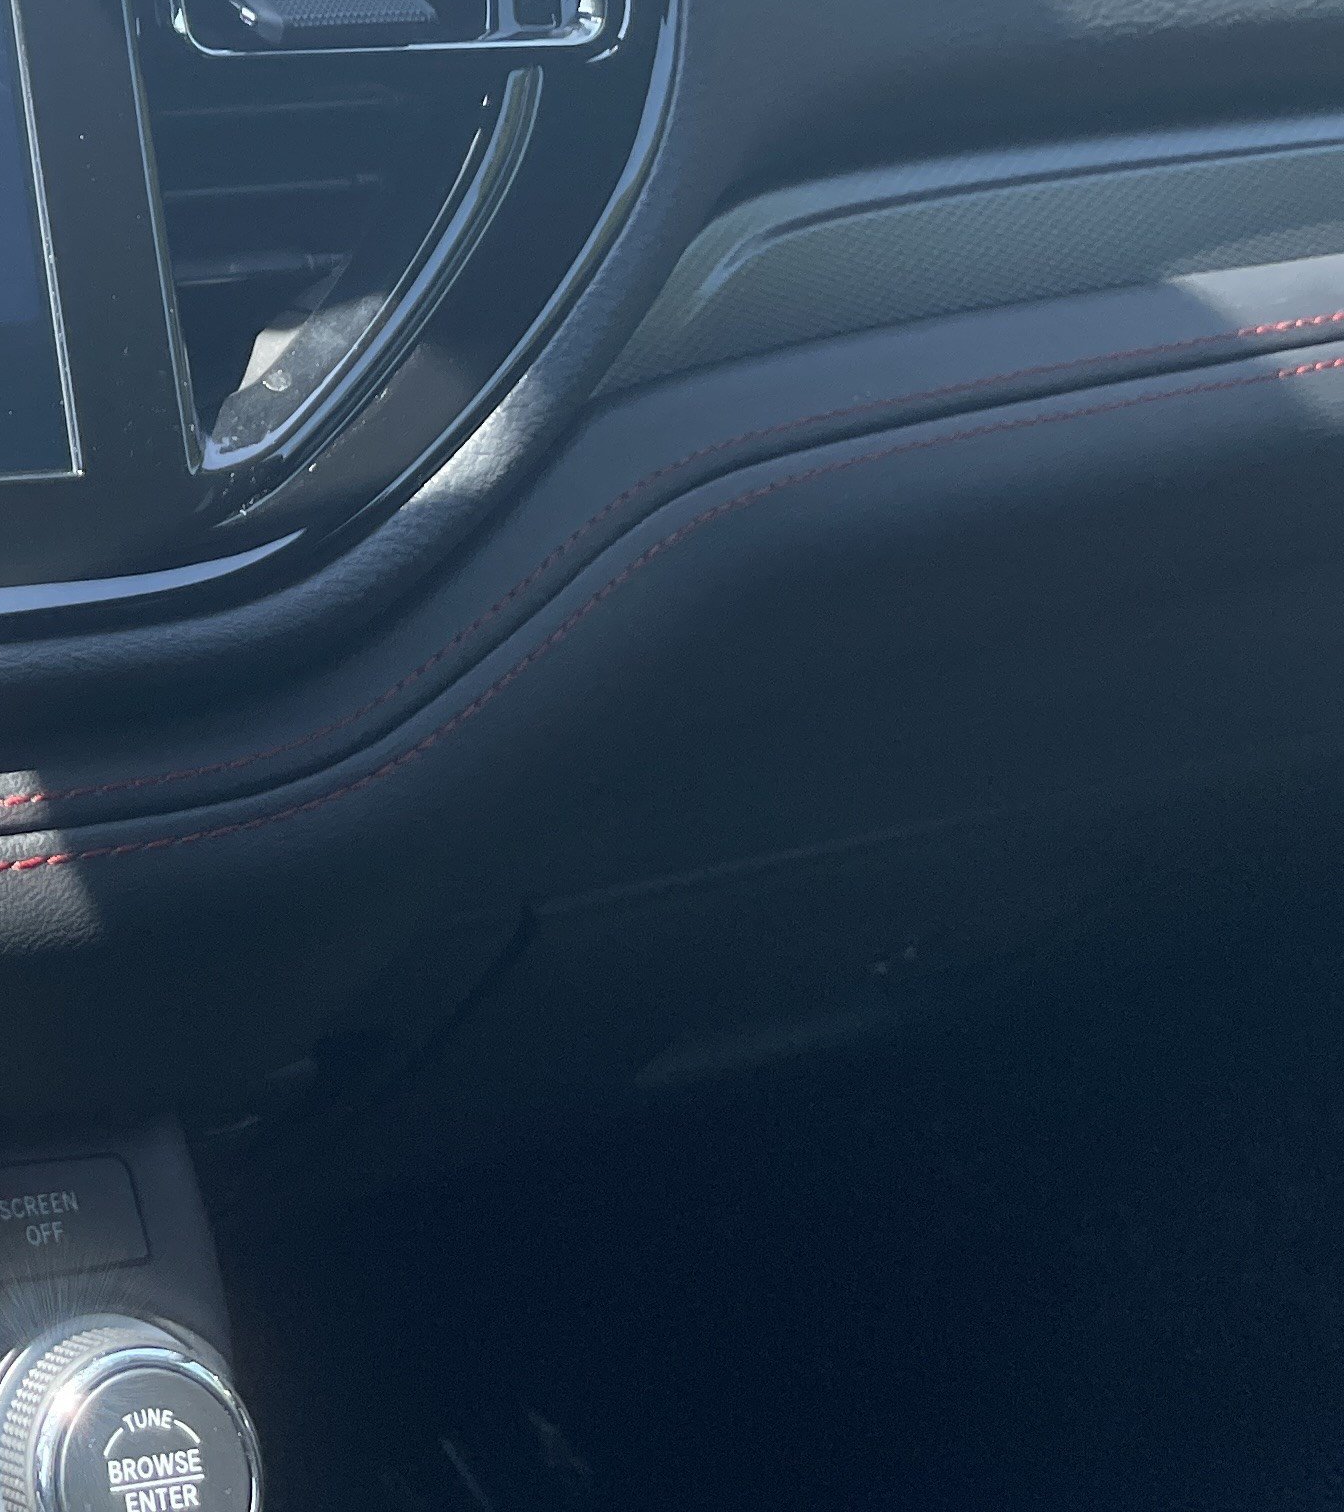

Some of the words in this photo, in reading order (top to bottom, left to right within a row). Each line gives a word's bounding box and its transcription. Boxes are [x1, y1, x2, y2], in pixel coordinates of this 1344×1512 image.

[25, 1220, 65, 1247] OFF
[121, 1407, 174, 1434] TUNE
[106, 1448, 204, 1485] BROWSE
[124, 1483, 201, 1512] ENTER
